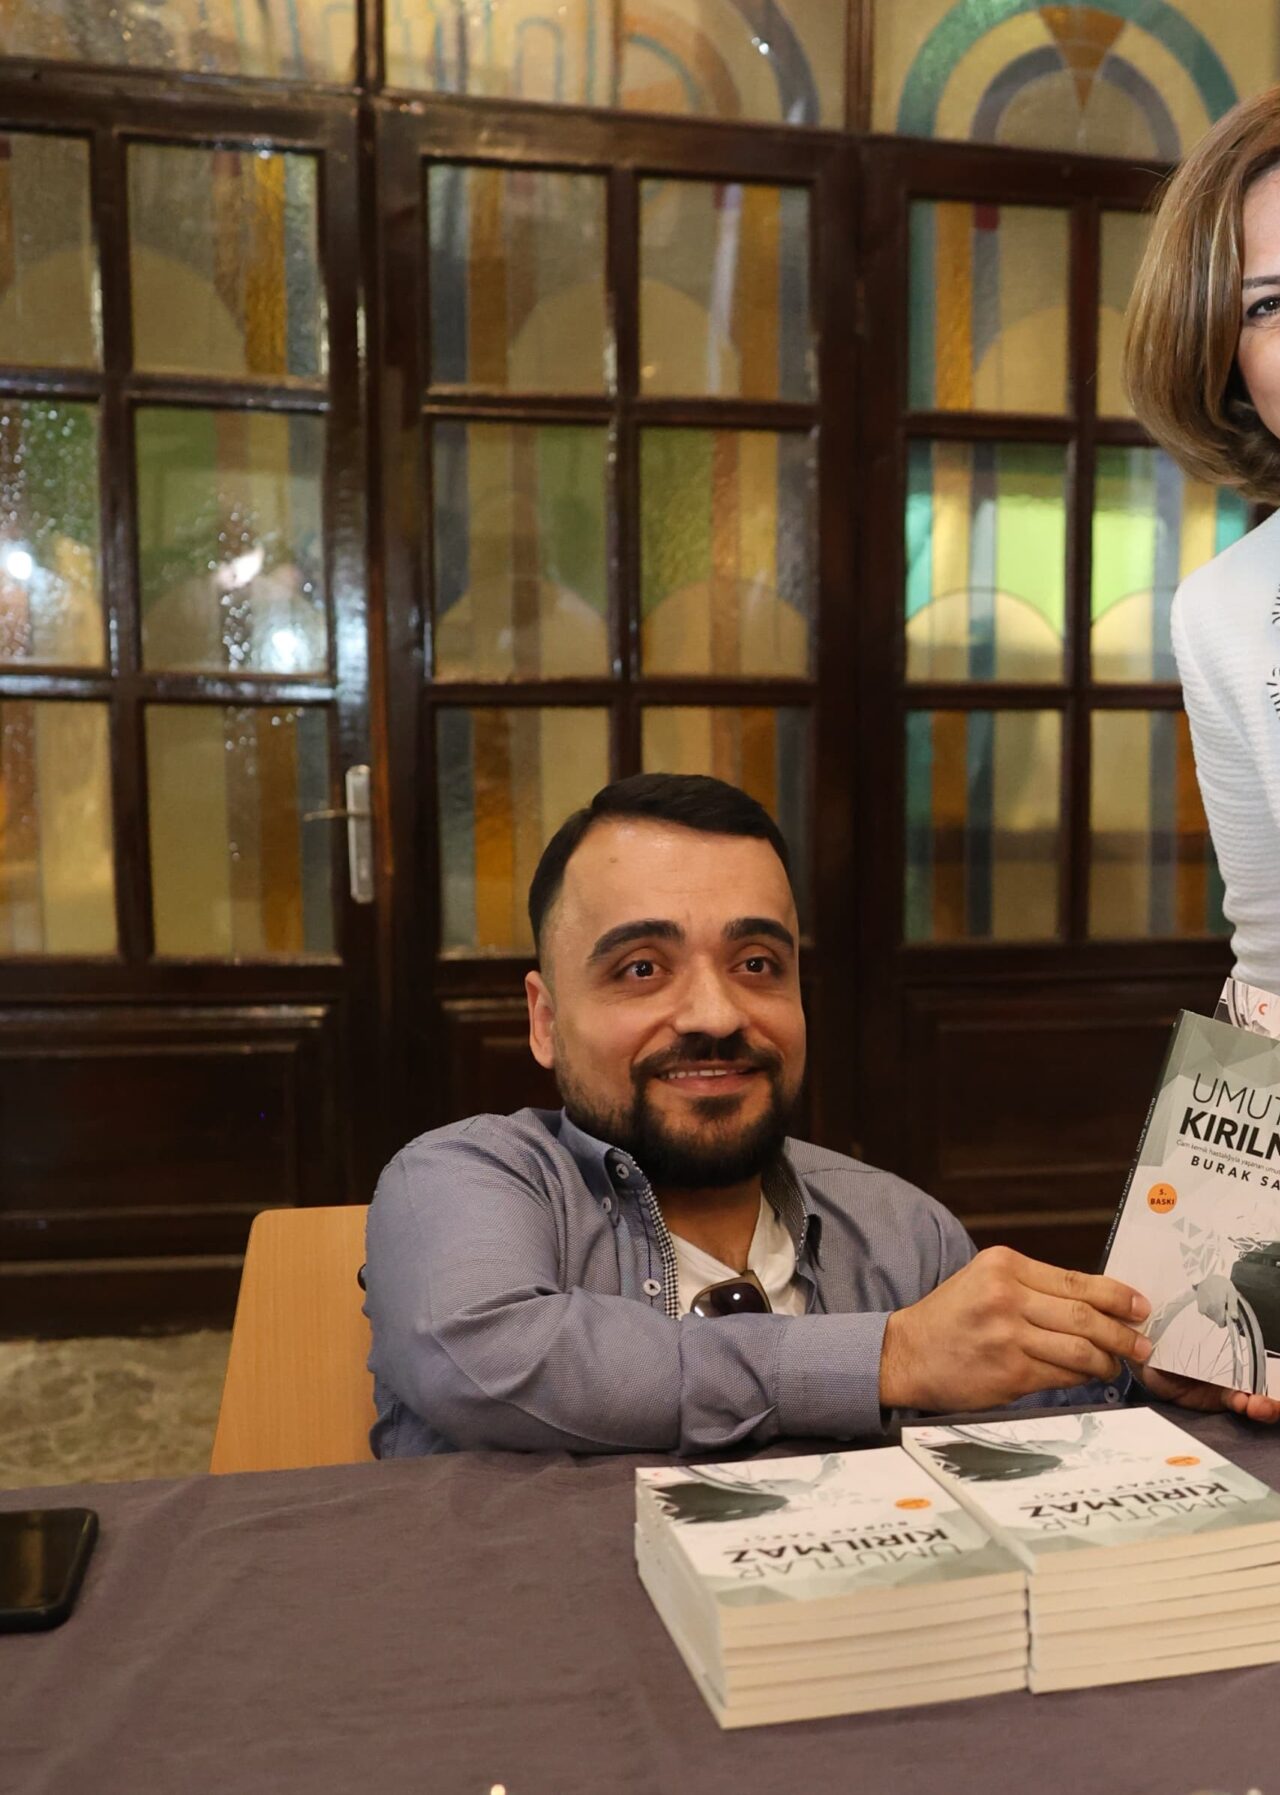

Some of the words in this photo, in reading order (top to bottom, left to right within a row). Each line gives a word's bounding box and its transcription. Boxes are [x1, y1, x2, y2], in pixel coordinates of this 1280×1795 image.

[1190, 1155, 1252, 1182] BURAK
[1150, 1197, 1176, 1206] BASKI
[1019, 1482, 1230, 1518] KIRILMAZ
[1034, 1494, 1247, 1531] UMUTLAR
[722, 1528, 950, 1564] KIRILMAZ
[731, 1542, 962, 1580] UMUTLAR
